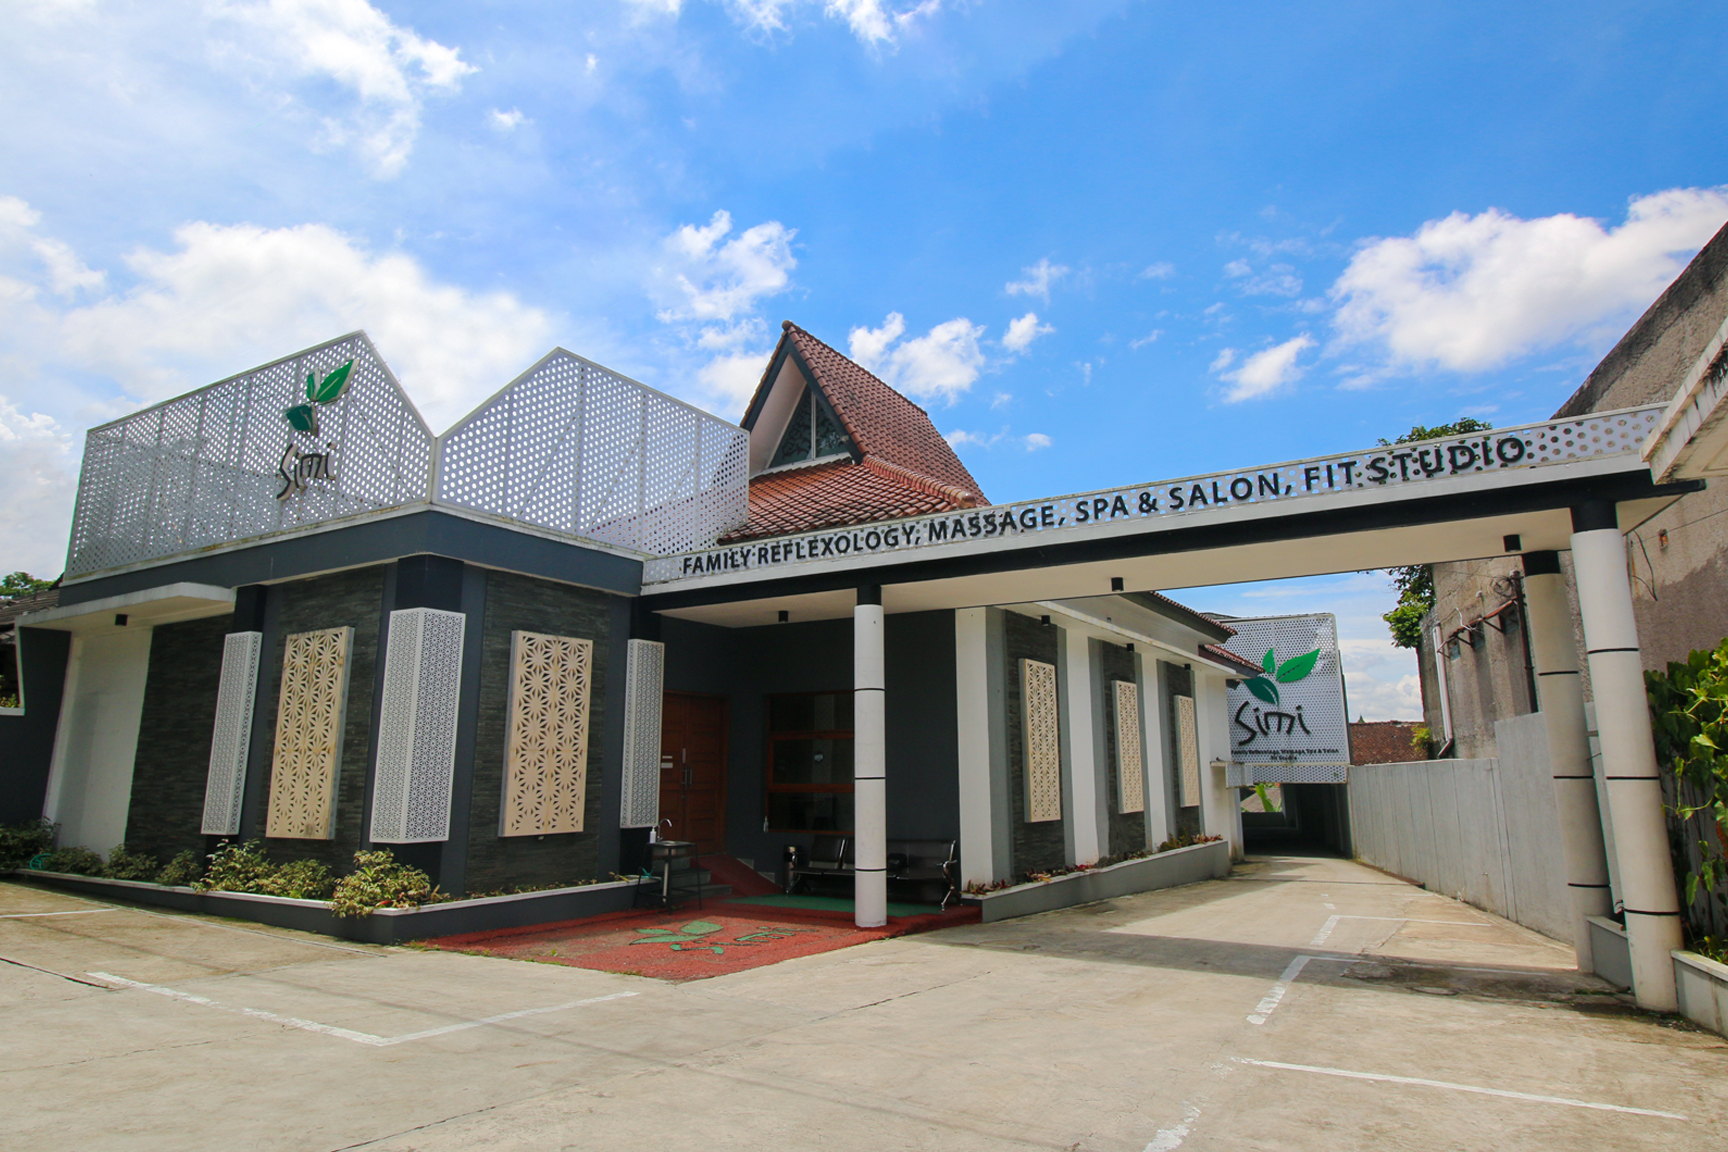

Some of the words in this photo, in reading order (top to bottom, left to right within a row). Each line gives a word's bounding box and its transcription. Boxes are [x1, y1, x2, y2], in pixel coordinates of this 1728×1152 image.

[682, 549, 751, 575] FAMILY
[757, 524, 921, 565] REFLEXOLOGY,
[928, 505, 1065, 542] MASSAGE,
[1075, 495, 1129, 522] SPA
[1138, 491, 1159, 513] &
[1169, 472, 1292, 511] SALON,
[1304, 460, 1357, 491] FIT
[1367, 436, 1526, 483] STUDIO
[1234, 700, 1312, 747] Simi
